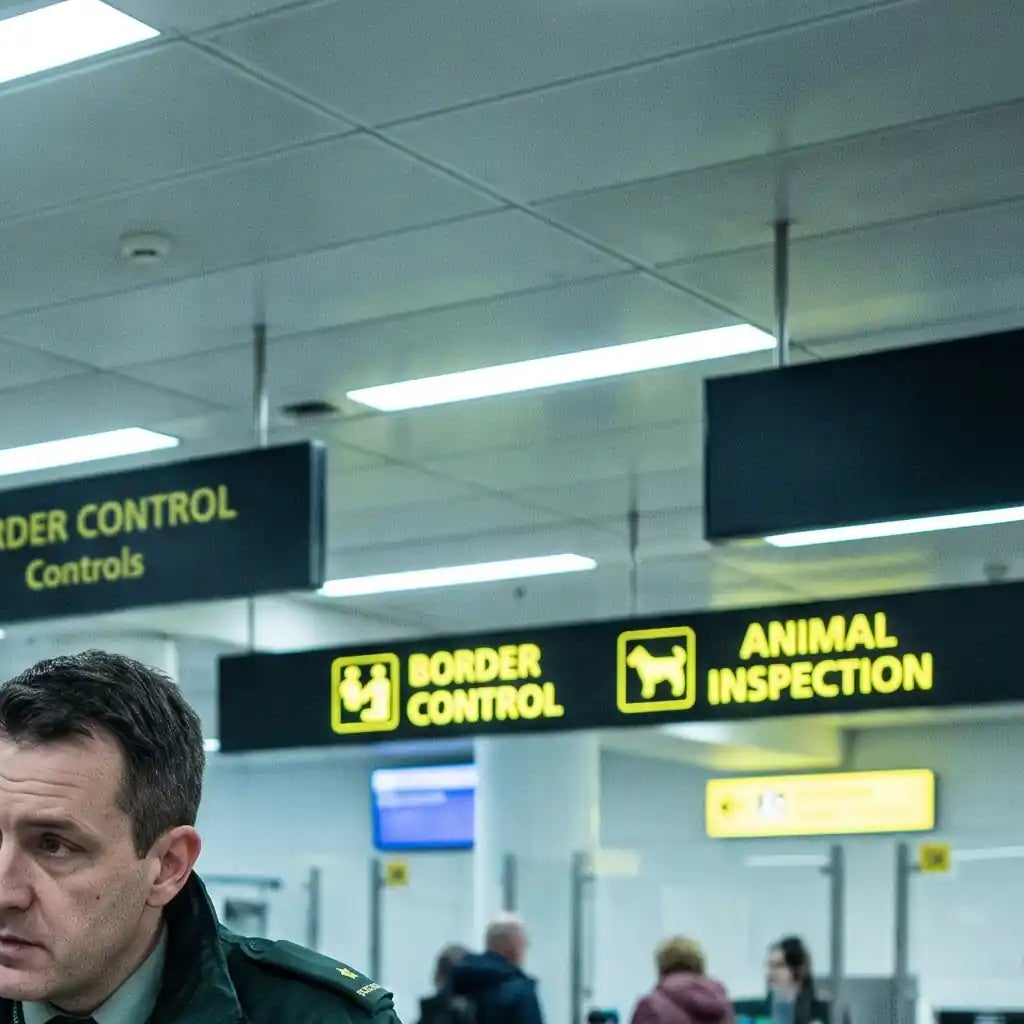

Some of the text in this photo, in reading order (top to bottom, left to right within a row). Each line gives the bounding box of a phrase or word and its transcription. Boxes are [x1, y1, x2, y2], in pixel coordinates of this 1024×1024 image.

[77, 485, 238, 540] CONTROL
[25, 546, 145, 590] Controls
[740, 612, 898, 660] ANIMAL
[408, 644, 541, 688] BORDER
[708, 653, 933, 706] INSPECTION
[407, 682, 565, 727] CONTROL
